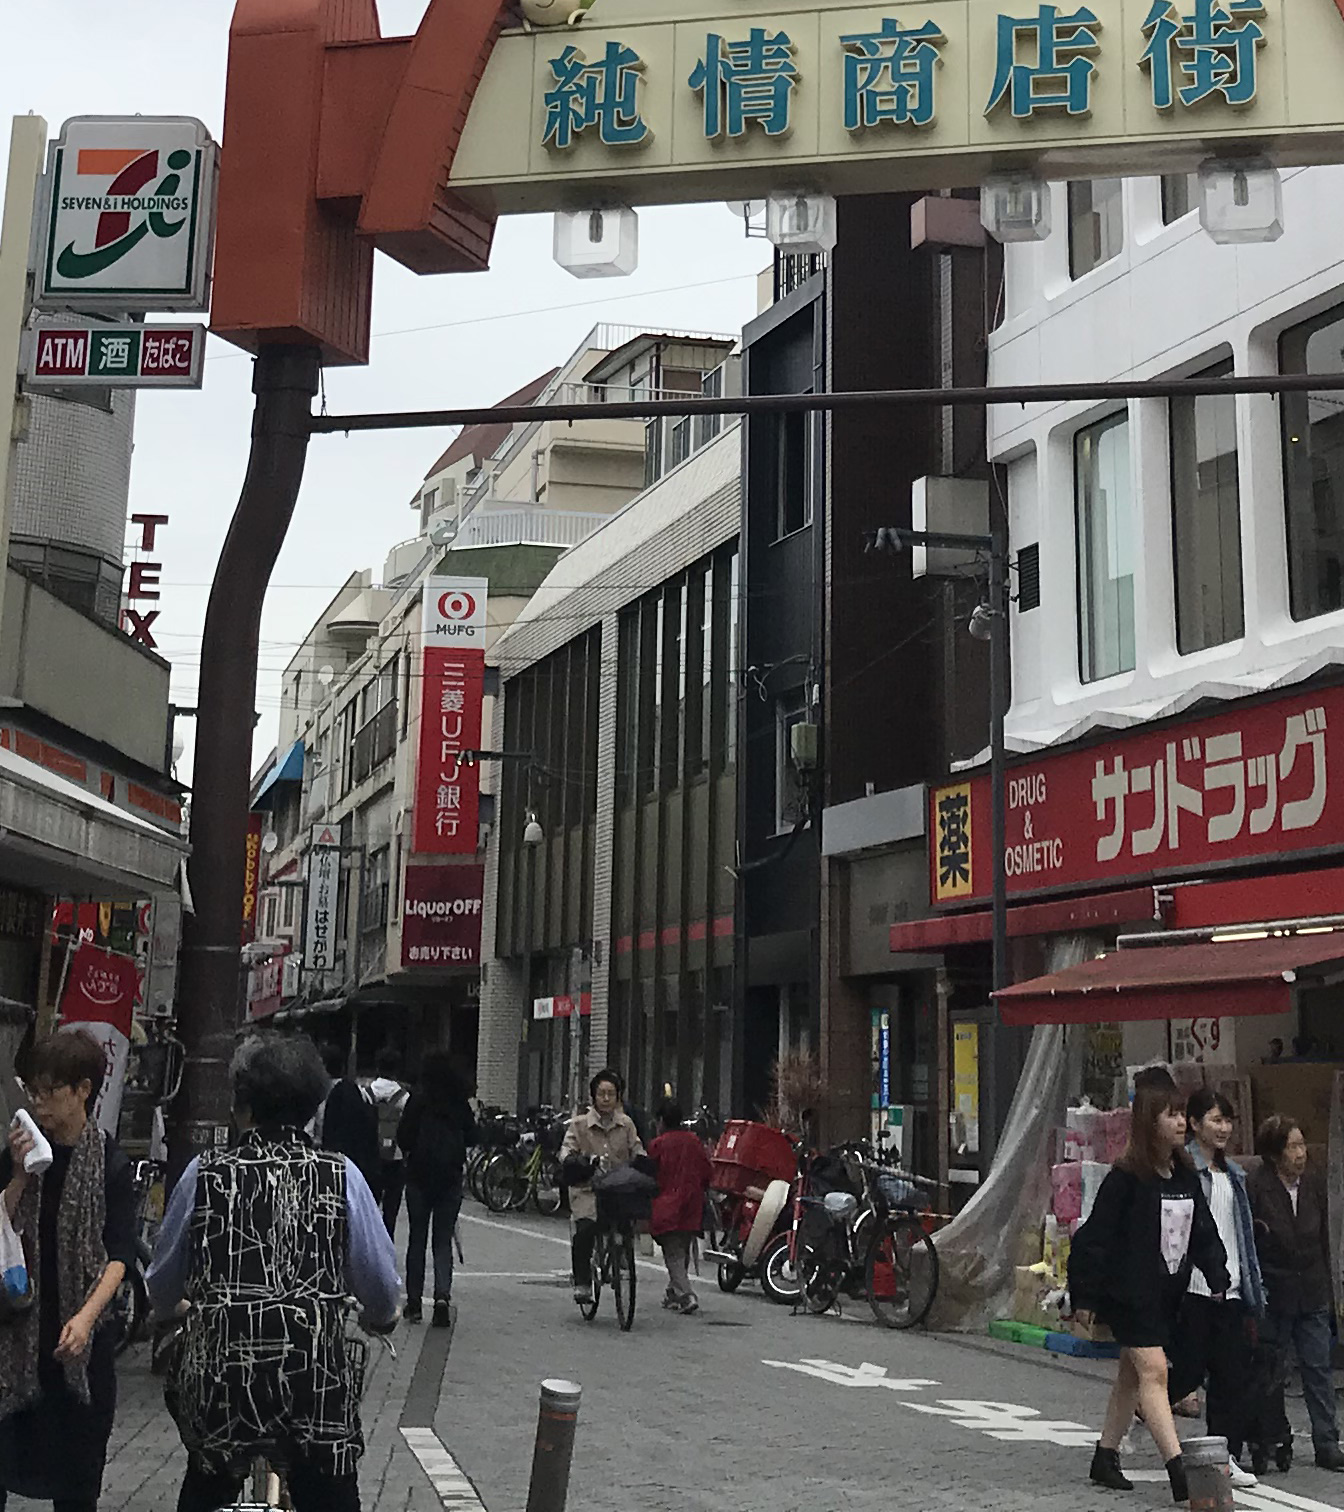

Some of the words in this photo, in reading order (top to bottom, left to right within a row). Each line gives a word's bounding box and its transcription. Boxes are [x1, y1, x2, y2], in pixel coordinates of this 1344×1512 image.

[121, 196, 188, 211] HOLDINGS
[40, 338, 85, 368] ATM
[99, 338, 131, 369] 酒
[144, 336, 189, 368] たばこ
[129, 514, 169, 648] TEX
[436, 624, 475, 637] MUFG
[435, 663, 464, 836] 三菱UFJ銀行
[1009, 773, 1046, 808] DRUG
[1092, 707, 1328, 863] サンドラッグ
[939, 792, 970, 888] 薬
[1024, 810, 1034, 839] &
[1004, 837, 1064, 877] OSMETIC
[312, 909, 329, 969] はせがわ
[409, 946, 472, 960] お売り下さい
